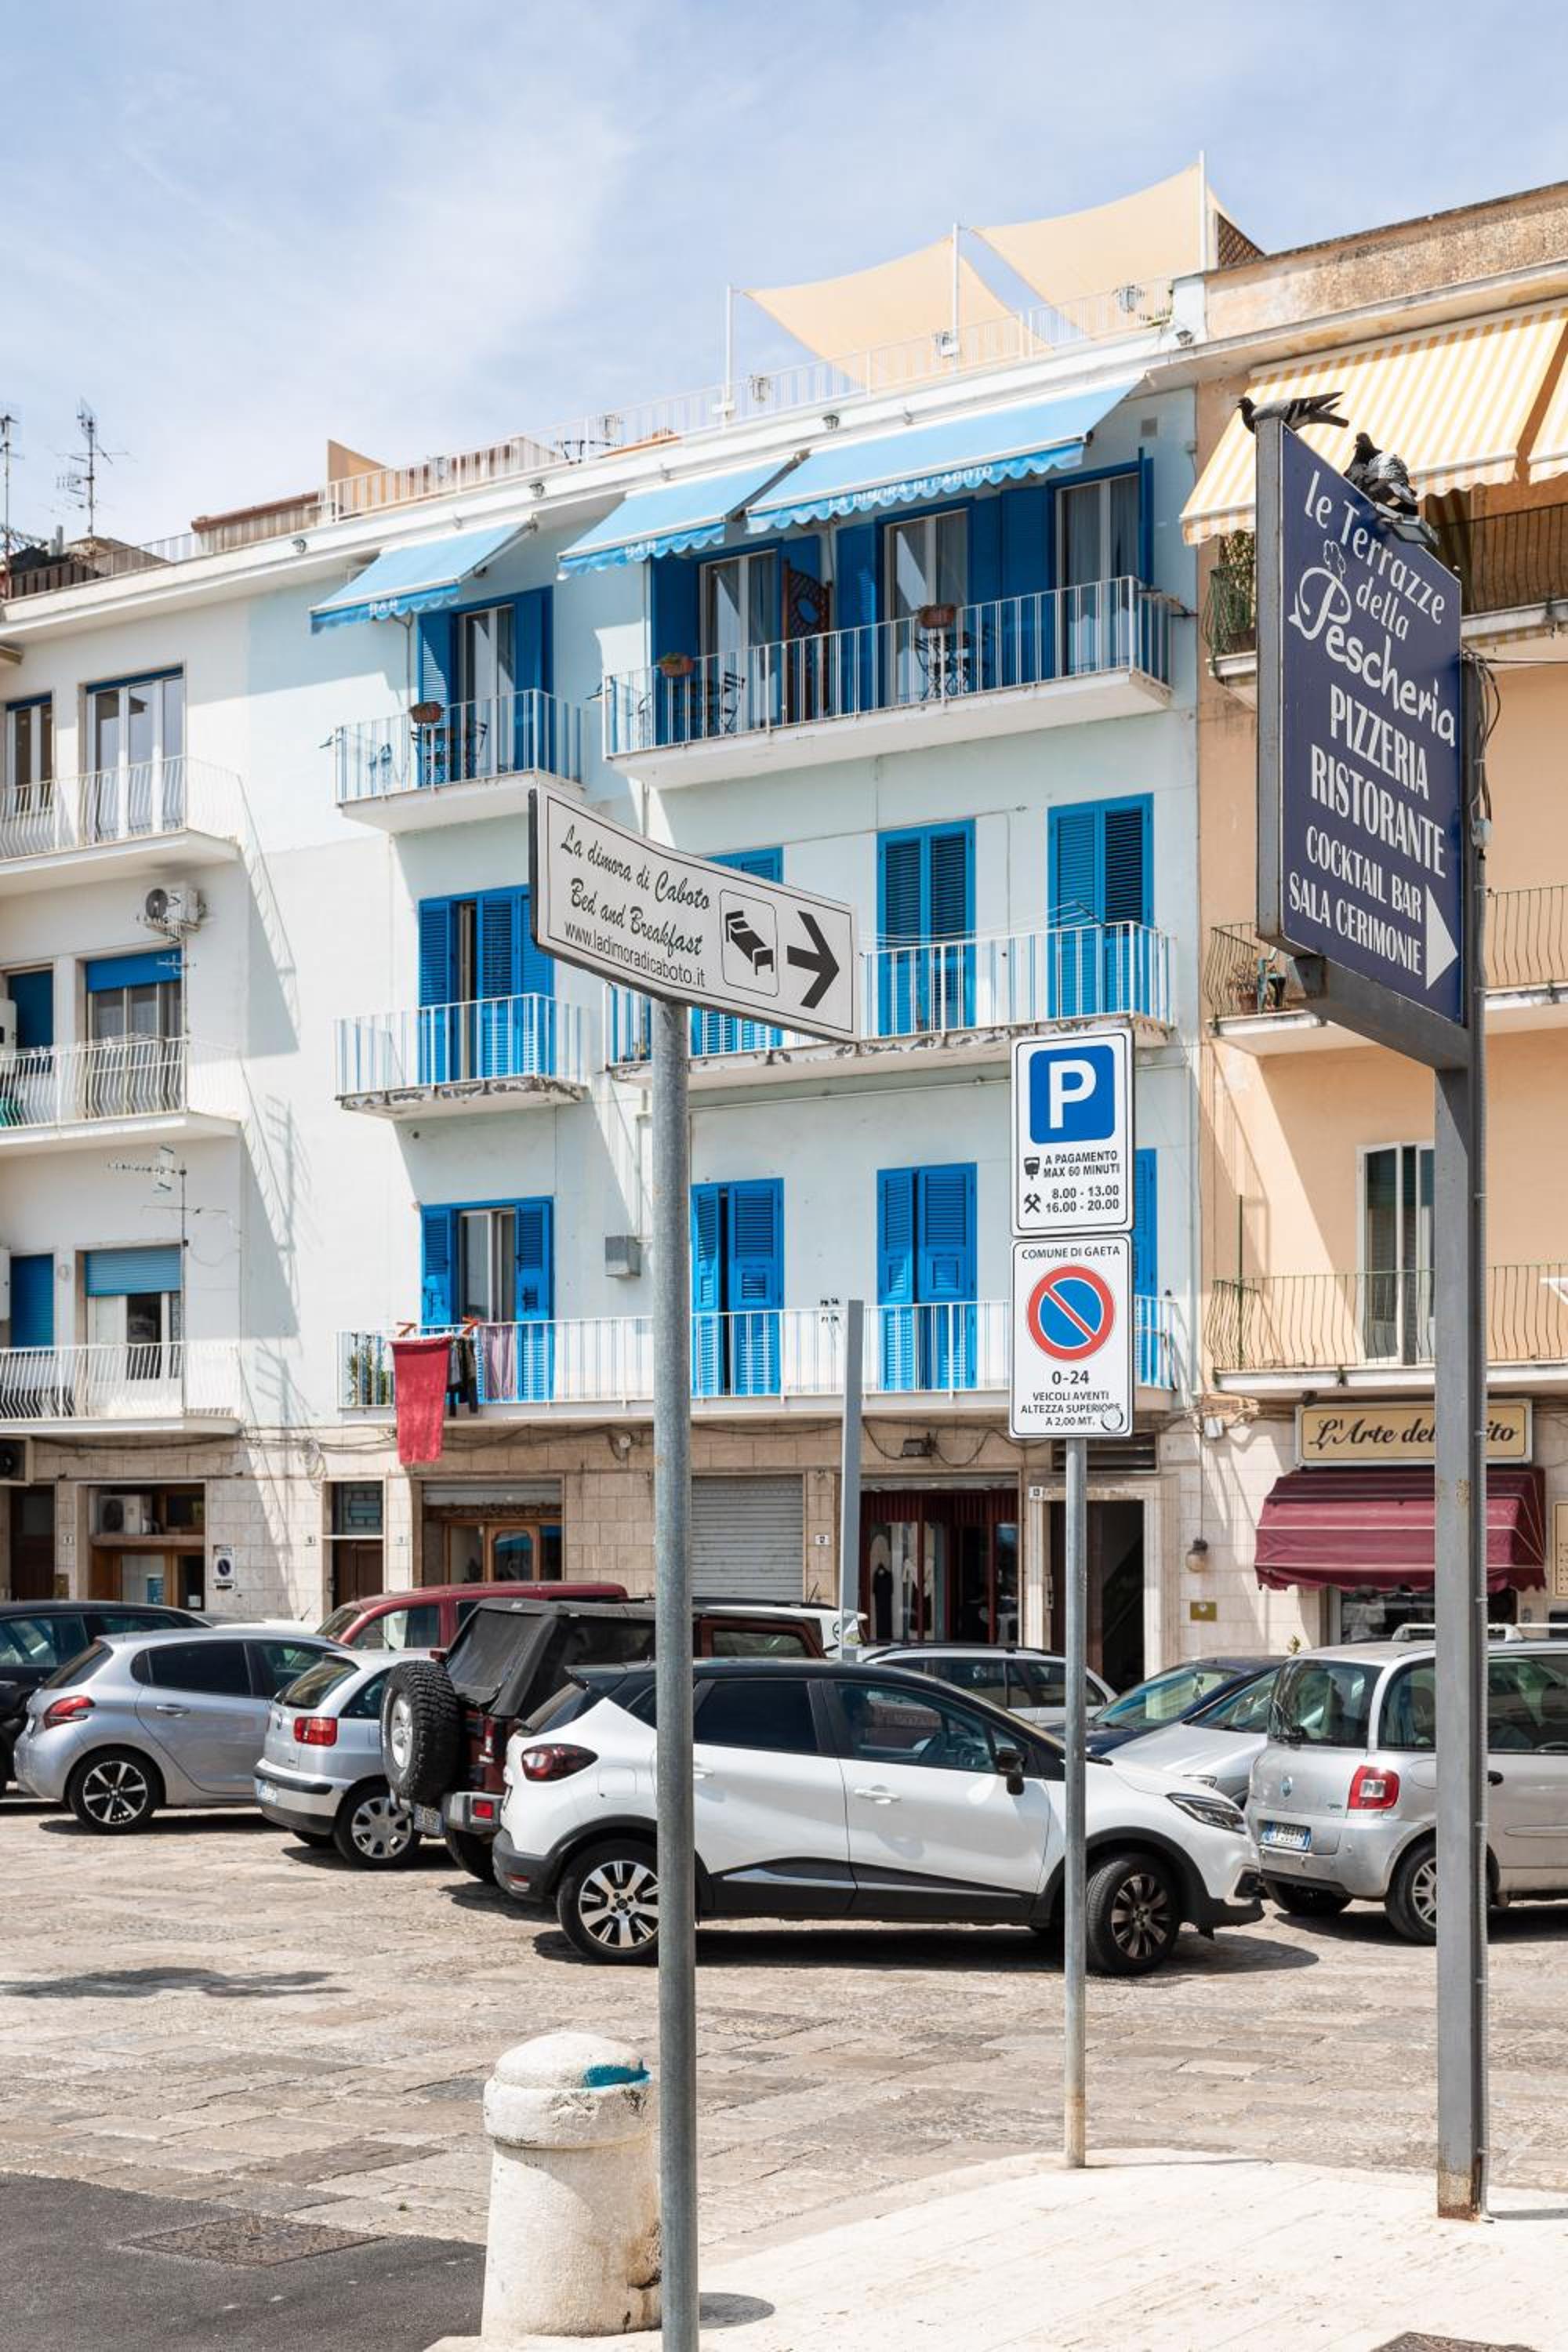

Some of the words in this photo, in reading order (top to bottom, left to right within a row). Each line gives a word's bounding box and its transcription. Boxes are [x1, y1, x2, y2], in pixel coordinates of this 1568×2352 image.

[829, 495, 848, 510] LA
[1305, 470, 1332, 528] le
[1341, 500, 1445, 625] Terrazze
[1356, 577, 1409, 641] della
[1330, 684, 1429, 800] PIZZERIA
[1311, 743, 1446, 878] RISTORANTE
[561, 825, 582, 859] La
[587, 840, 633, 883] dimora
[637, 865, 650, 891] di
[654, 870, 710, 910] Caboto
[1306, 826, 1386, 904] COCKTAIL
[1392, 874, 1421, 923] BAR
[570, 877, 597, 915] Bed
[601, 900, 626, 928] and
[630, 906, 702, 956] Breakfast
[1289, 871, 1331, 929] SALA
[1335, 898, 1423, 976] CERIMONIE
[1049, 1059, 1097, 1129] P
[1044, 1167, 1065, 1178] MAX
[1069, 1166, 1080, 1177] 60
[1083, 1163, 1120, 1177] MINUTI
[1045, 1155, 1052, 1165] A
[1054, 1150, 1118, 1164] PAGAMENTO
[1046, 1201, 1076, 1214] 16.00
[1087, 1199, 1119, 1211] 20.00
[1052, 1188, 1076, 1200] 8.00
[1088, 1185, 1119, 1197] 13.00
[1022, 1248, 1068, 1259] COMUNE
[1071, 1247, 1082, 1257] DI
[1084, 1246, 1120, 1257] GAETA
[1021, 1404, 1064, 1414] ALTEZZA
[1033, 1392, 1069, 1401] VEICOLI
[1073, 1391, 1109, 1401] AVENTI
[1045, 1417, 1052, 1426] A
[1077, 1416, 1095, 1426] MT.
[1308, 1418, 1397, 1451] L'Arte
